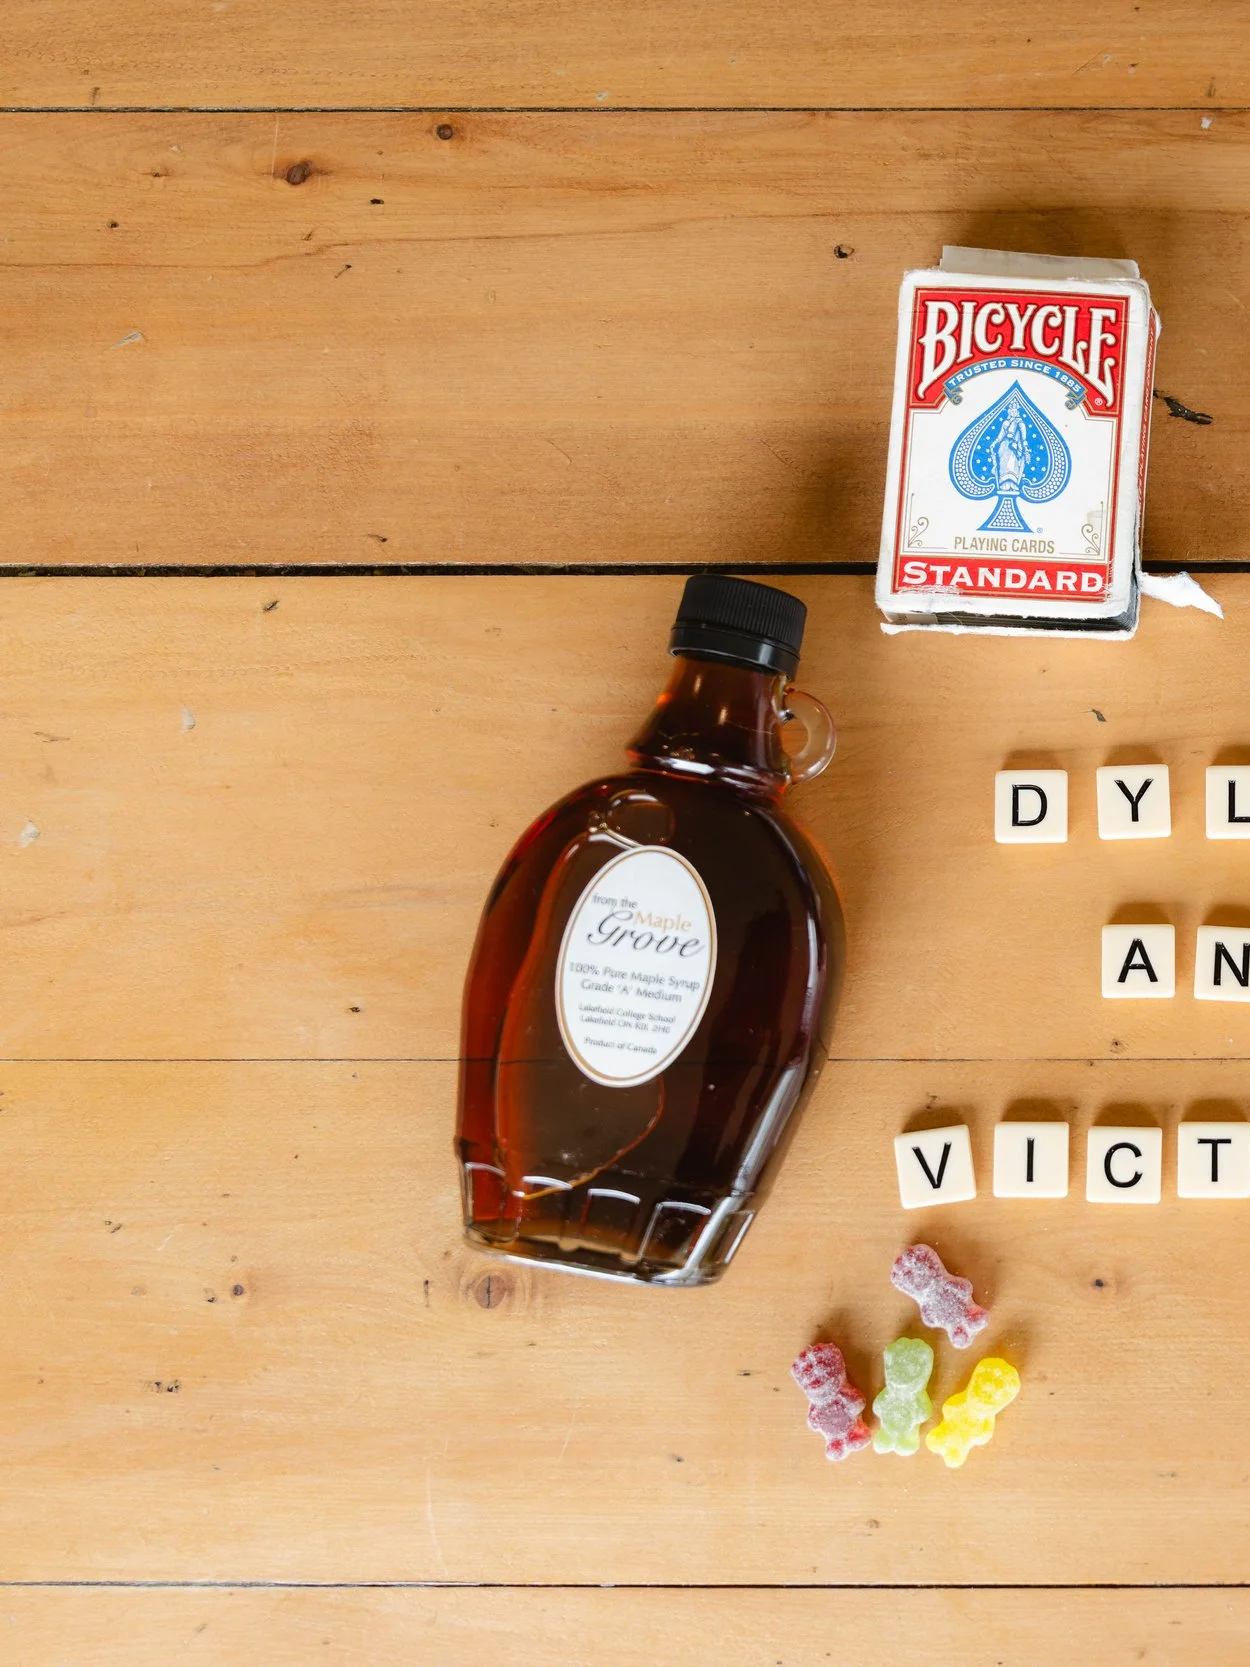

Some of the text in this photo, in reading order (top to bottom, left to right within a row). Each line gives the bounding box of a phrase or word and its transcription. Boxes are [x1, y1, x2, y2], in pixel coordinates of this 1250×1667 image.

[918, 301, 1117, 408] BICYCLE
[949, 359, 1081, 392] TRUSTED SINCE 1885
[954, 537, 1055, 554] PLAYING CARDS
[902, 561, 1104, 593] STANDARD
[593, 892, 638, 908] from the
[587, 910, 706, 957] Grove
[634, 910, 692, 933] Maple
[569, 962, 700, 992] 100% Pure Maple Syrup
[580, 979, 614, 993] Grade
[636, 988, 682, 1003] Medium
[616, 1007, 646, 1020] College
[648, 1011, 676, 1023] School
[584, 1036, 657, 1055] Product of Canada
